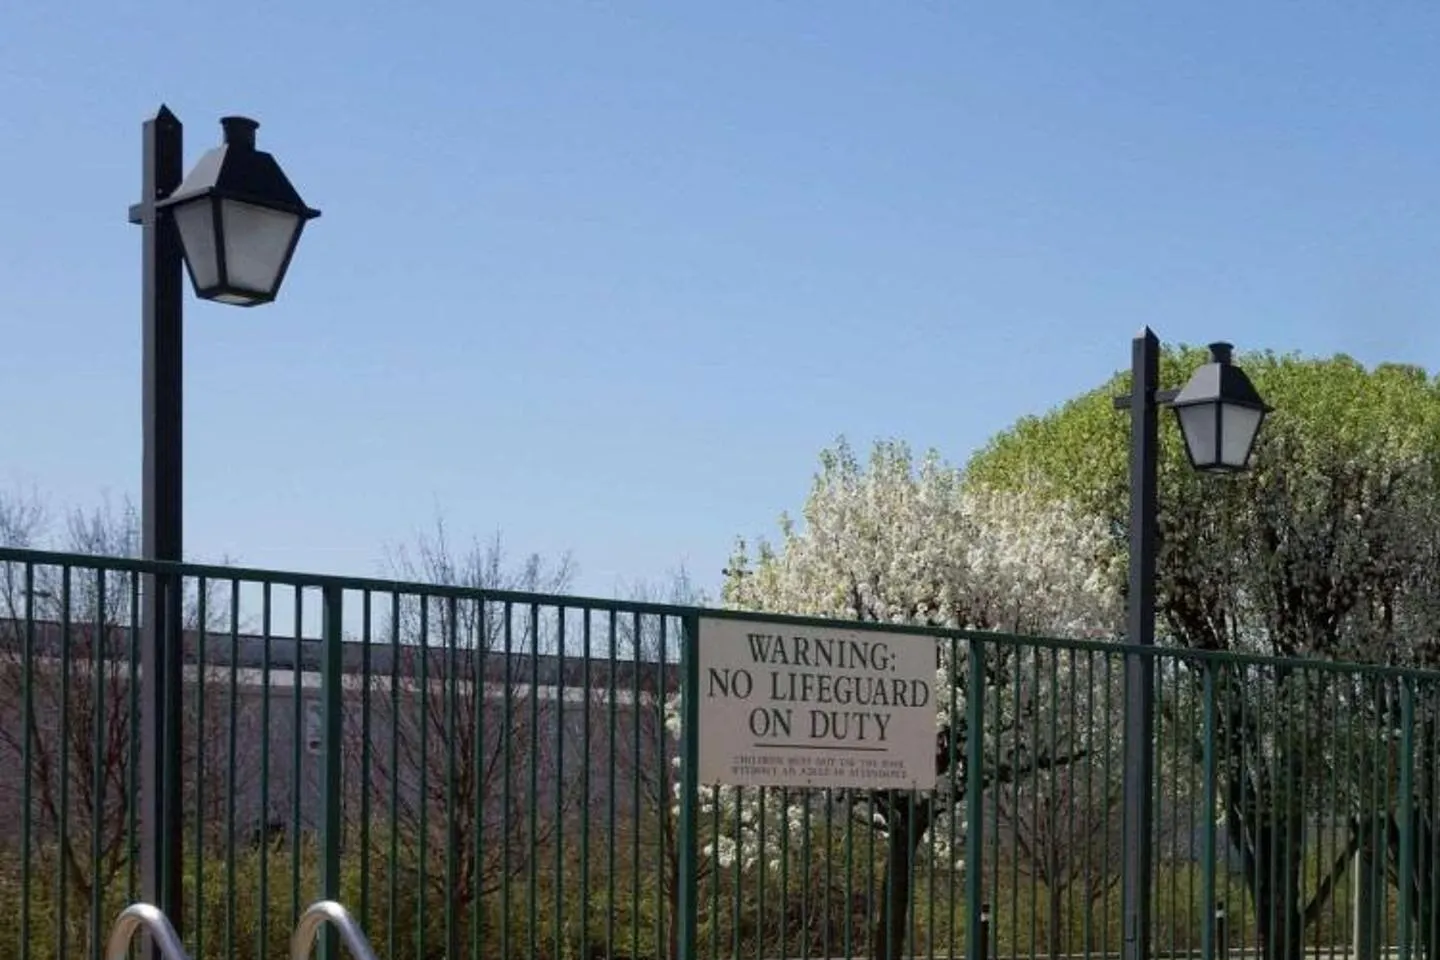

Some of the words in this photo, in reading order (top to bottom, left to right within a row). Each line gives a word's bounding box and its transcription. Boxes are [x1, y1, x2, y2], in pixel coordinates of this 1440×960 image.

[747, 633, 897, 672] WARNING:
[708, 668, 752, 698] NO
[770, 672, 930, 708] LIFEGUARD
[750, 707, 792, 738] ON
[809, 710, 891, 741] DUTY
